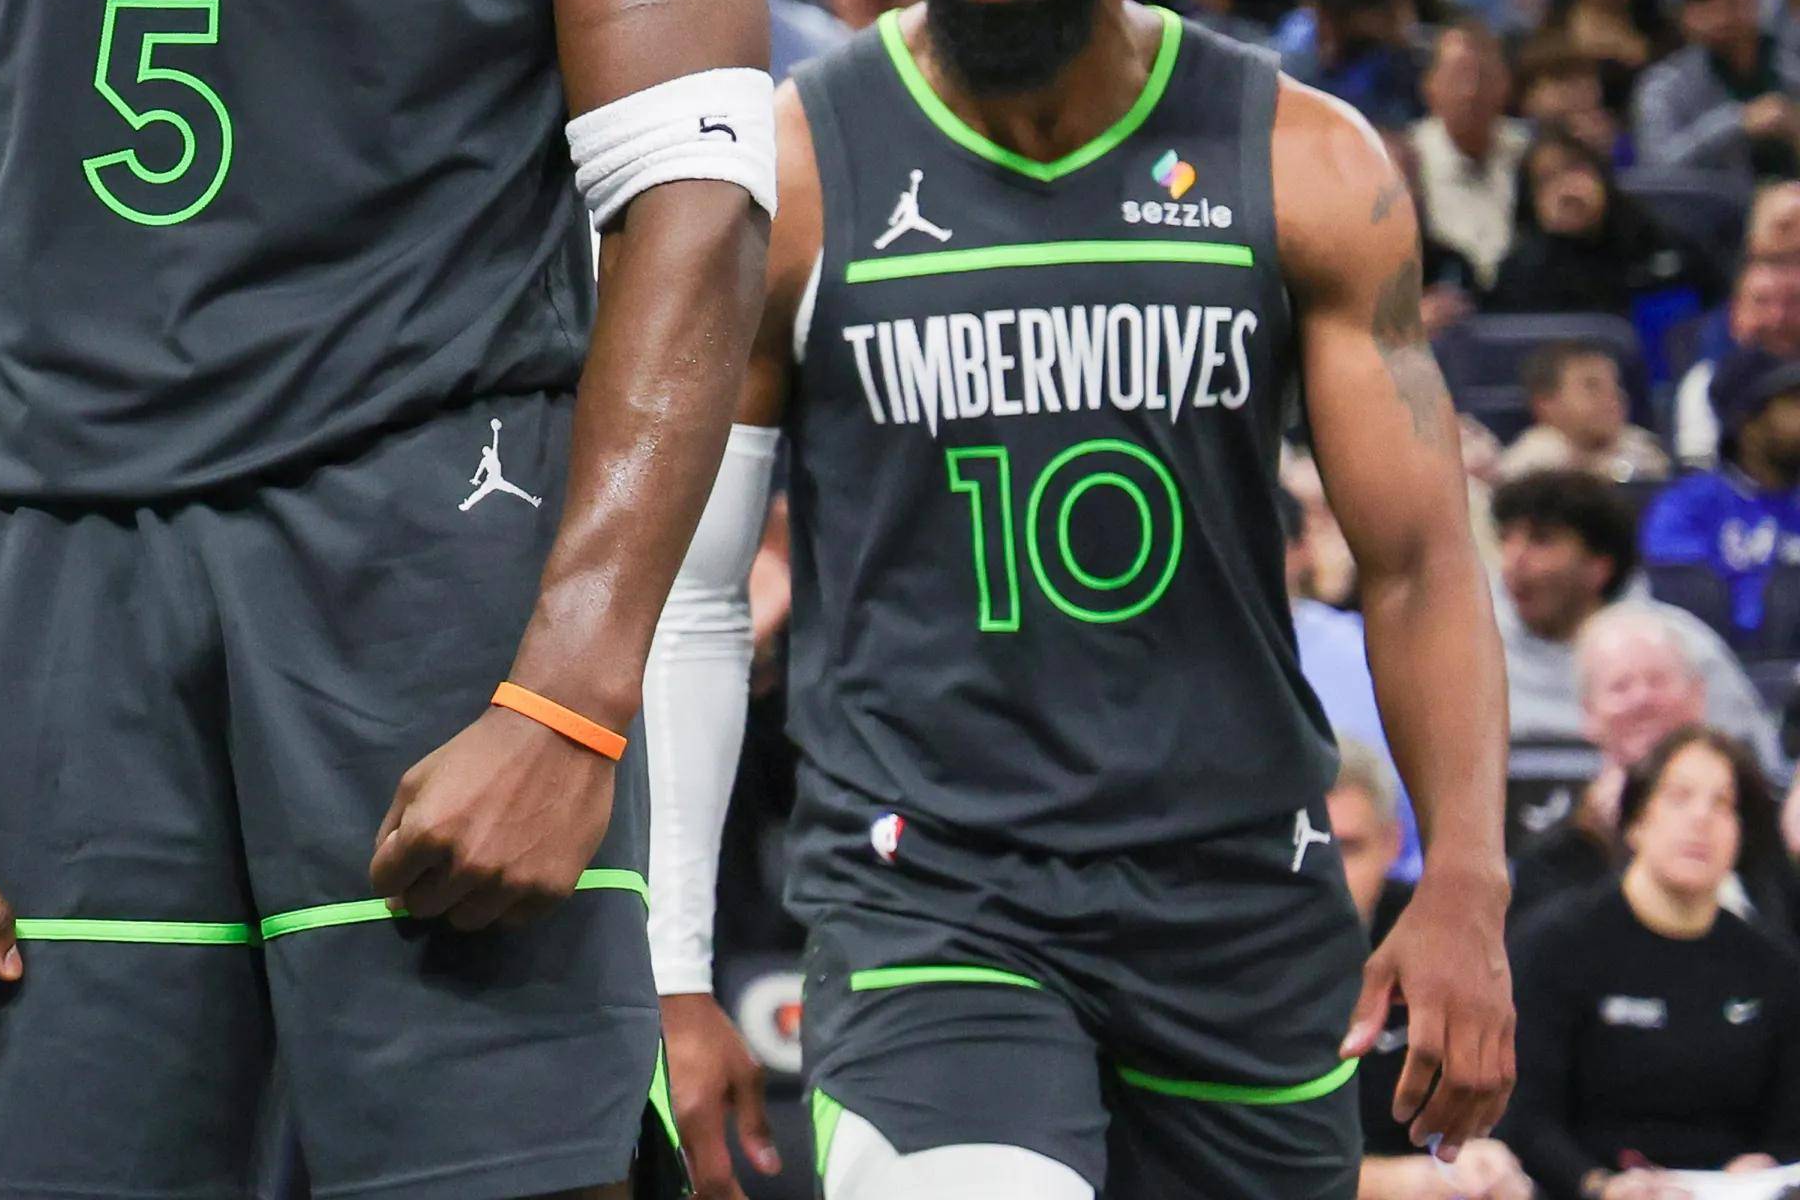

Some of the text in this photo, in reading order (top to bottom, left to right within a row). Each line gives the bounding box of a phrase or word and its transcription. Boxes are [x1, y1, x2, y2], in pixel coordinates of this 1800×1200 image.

[699, 113, 737, 142] 5
[1122, 197, 1233, 228] sezzle
[842, 302, 1258, 440] TIMBERWOLVES
[945, 438, 1183, 633] 10
